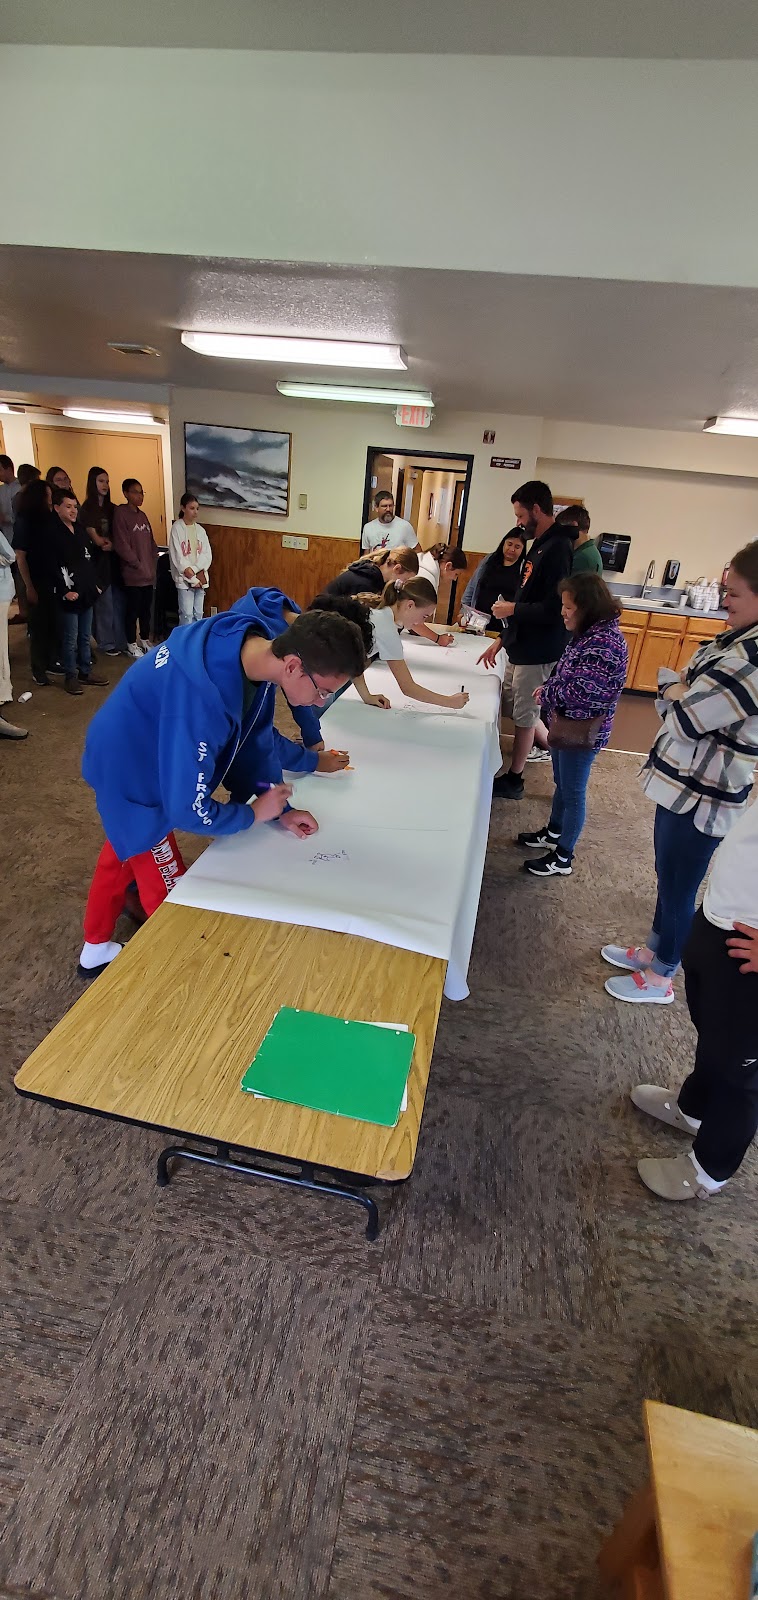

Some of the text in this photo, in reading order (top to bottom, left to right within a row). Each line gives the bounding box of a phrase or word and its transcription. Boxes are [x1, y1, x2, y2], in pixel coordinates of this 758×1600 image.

[401, 404, 426, 426] EXIT
[198, 741, 207, 762] ST
[150, 836, 174, 865] ND
